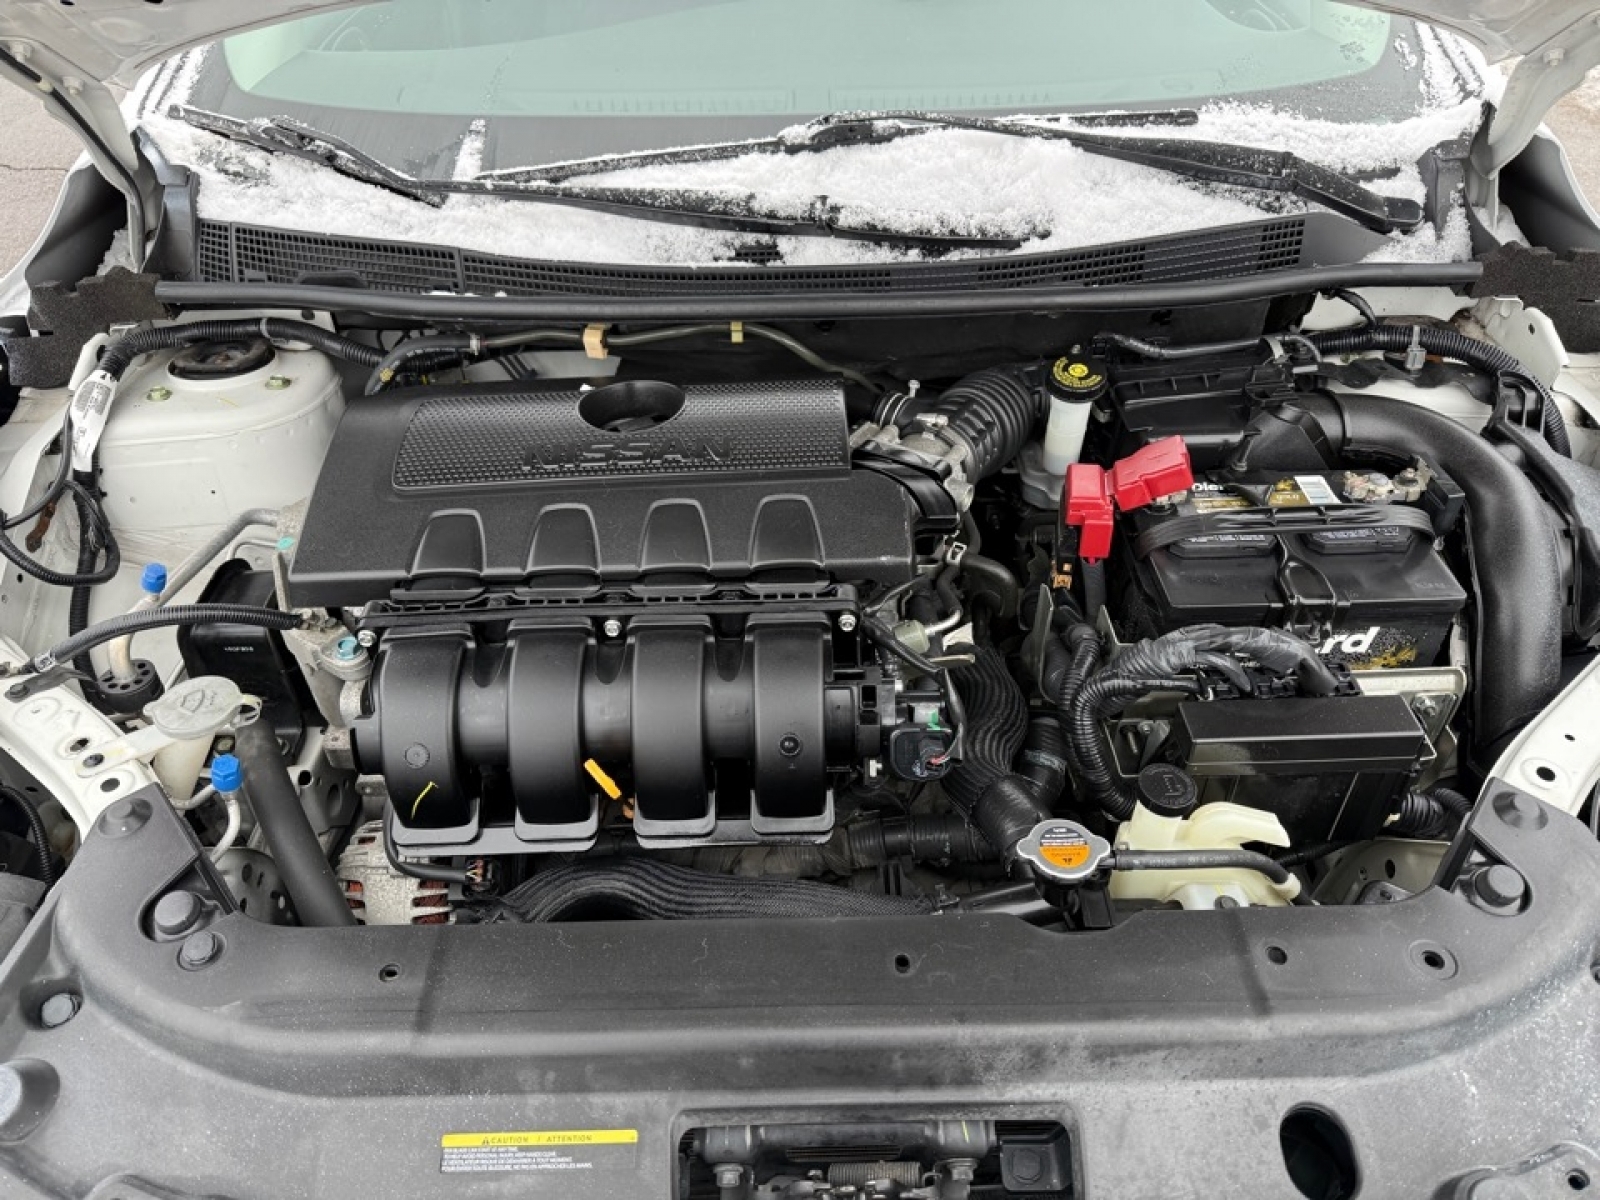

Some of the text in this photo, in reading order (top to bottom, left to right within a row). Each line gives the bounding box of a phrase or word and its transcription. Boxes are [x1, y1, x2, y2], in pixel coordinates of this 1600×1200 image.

[521, 437, 733, 470] NISSAN
[1315, 626, 1381, 653] rd
[491, 1136, 529, 1144] CAUTION
[546, 1134, 593, 1143] ATTENTION
